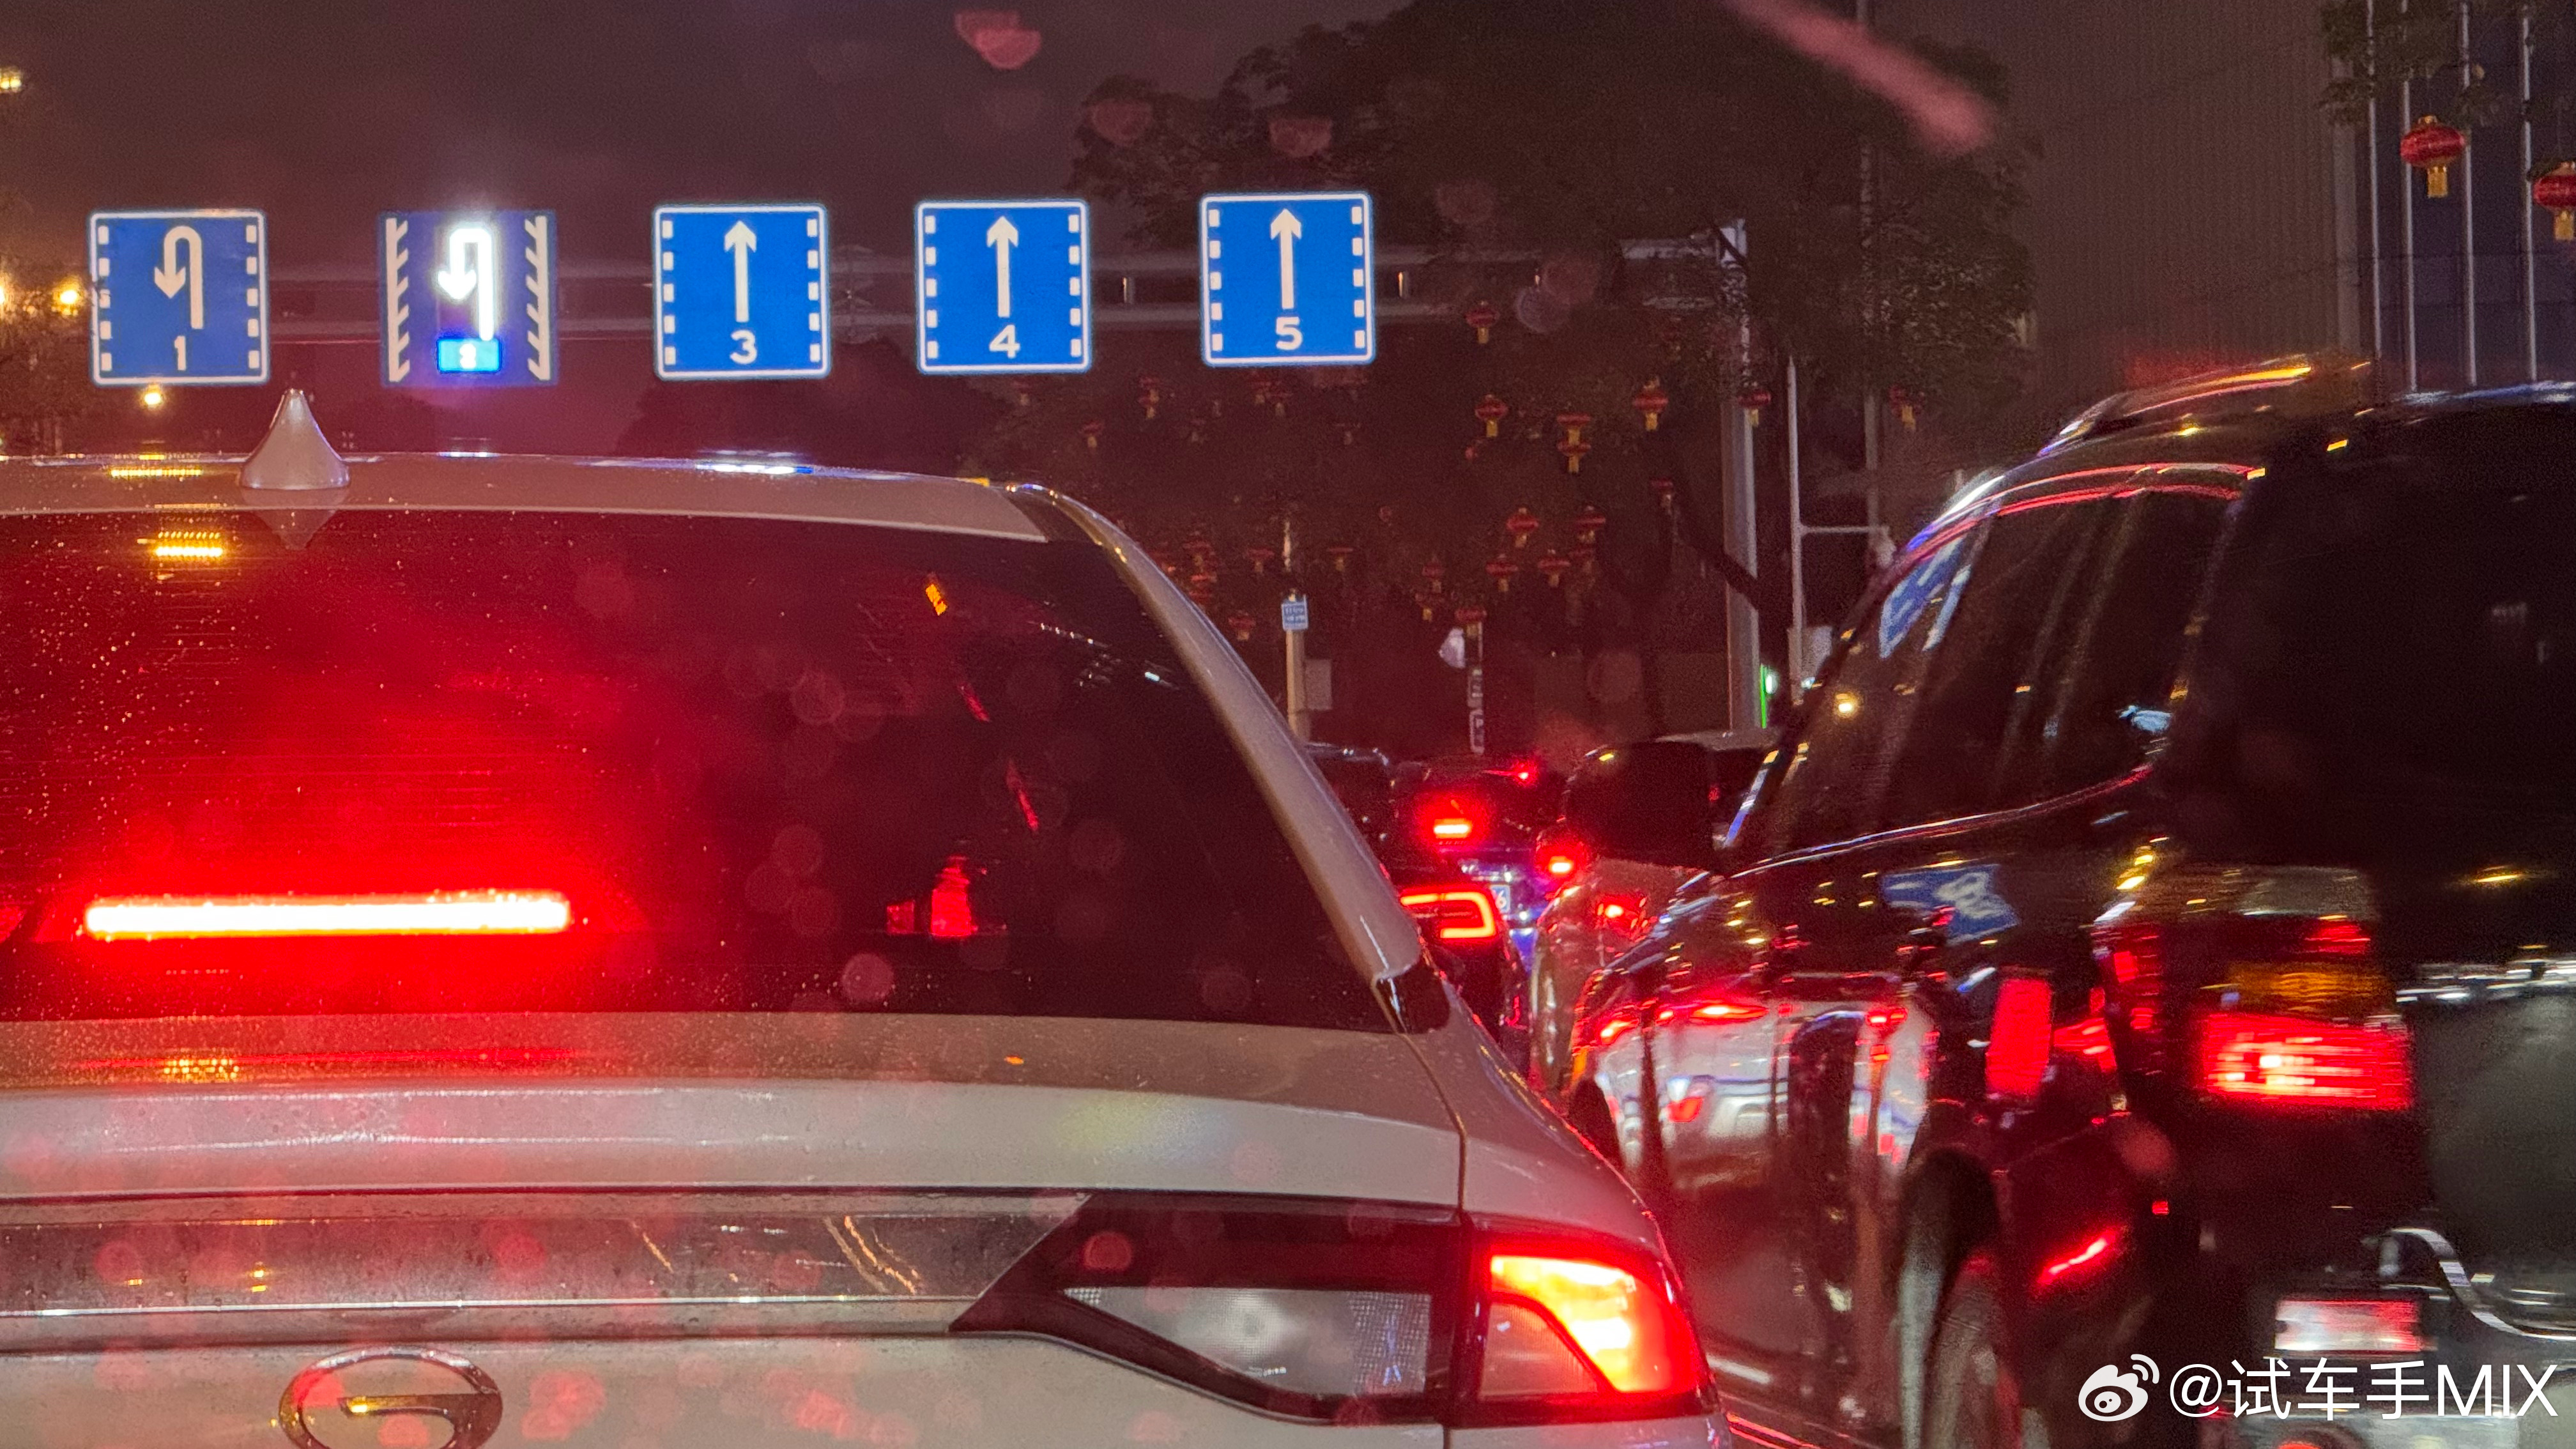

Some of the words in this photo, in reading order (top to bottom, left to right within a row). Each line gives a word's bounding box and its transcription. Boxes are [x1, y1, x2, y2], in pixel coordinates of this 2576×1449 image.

[730, 330, 758, 365] 3
[989, 324, 1021, 358] 4
[1275, 316, 1303, 351] 5
[174, 336, 187, 371] 1
